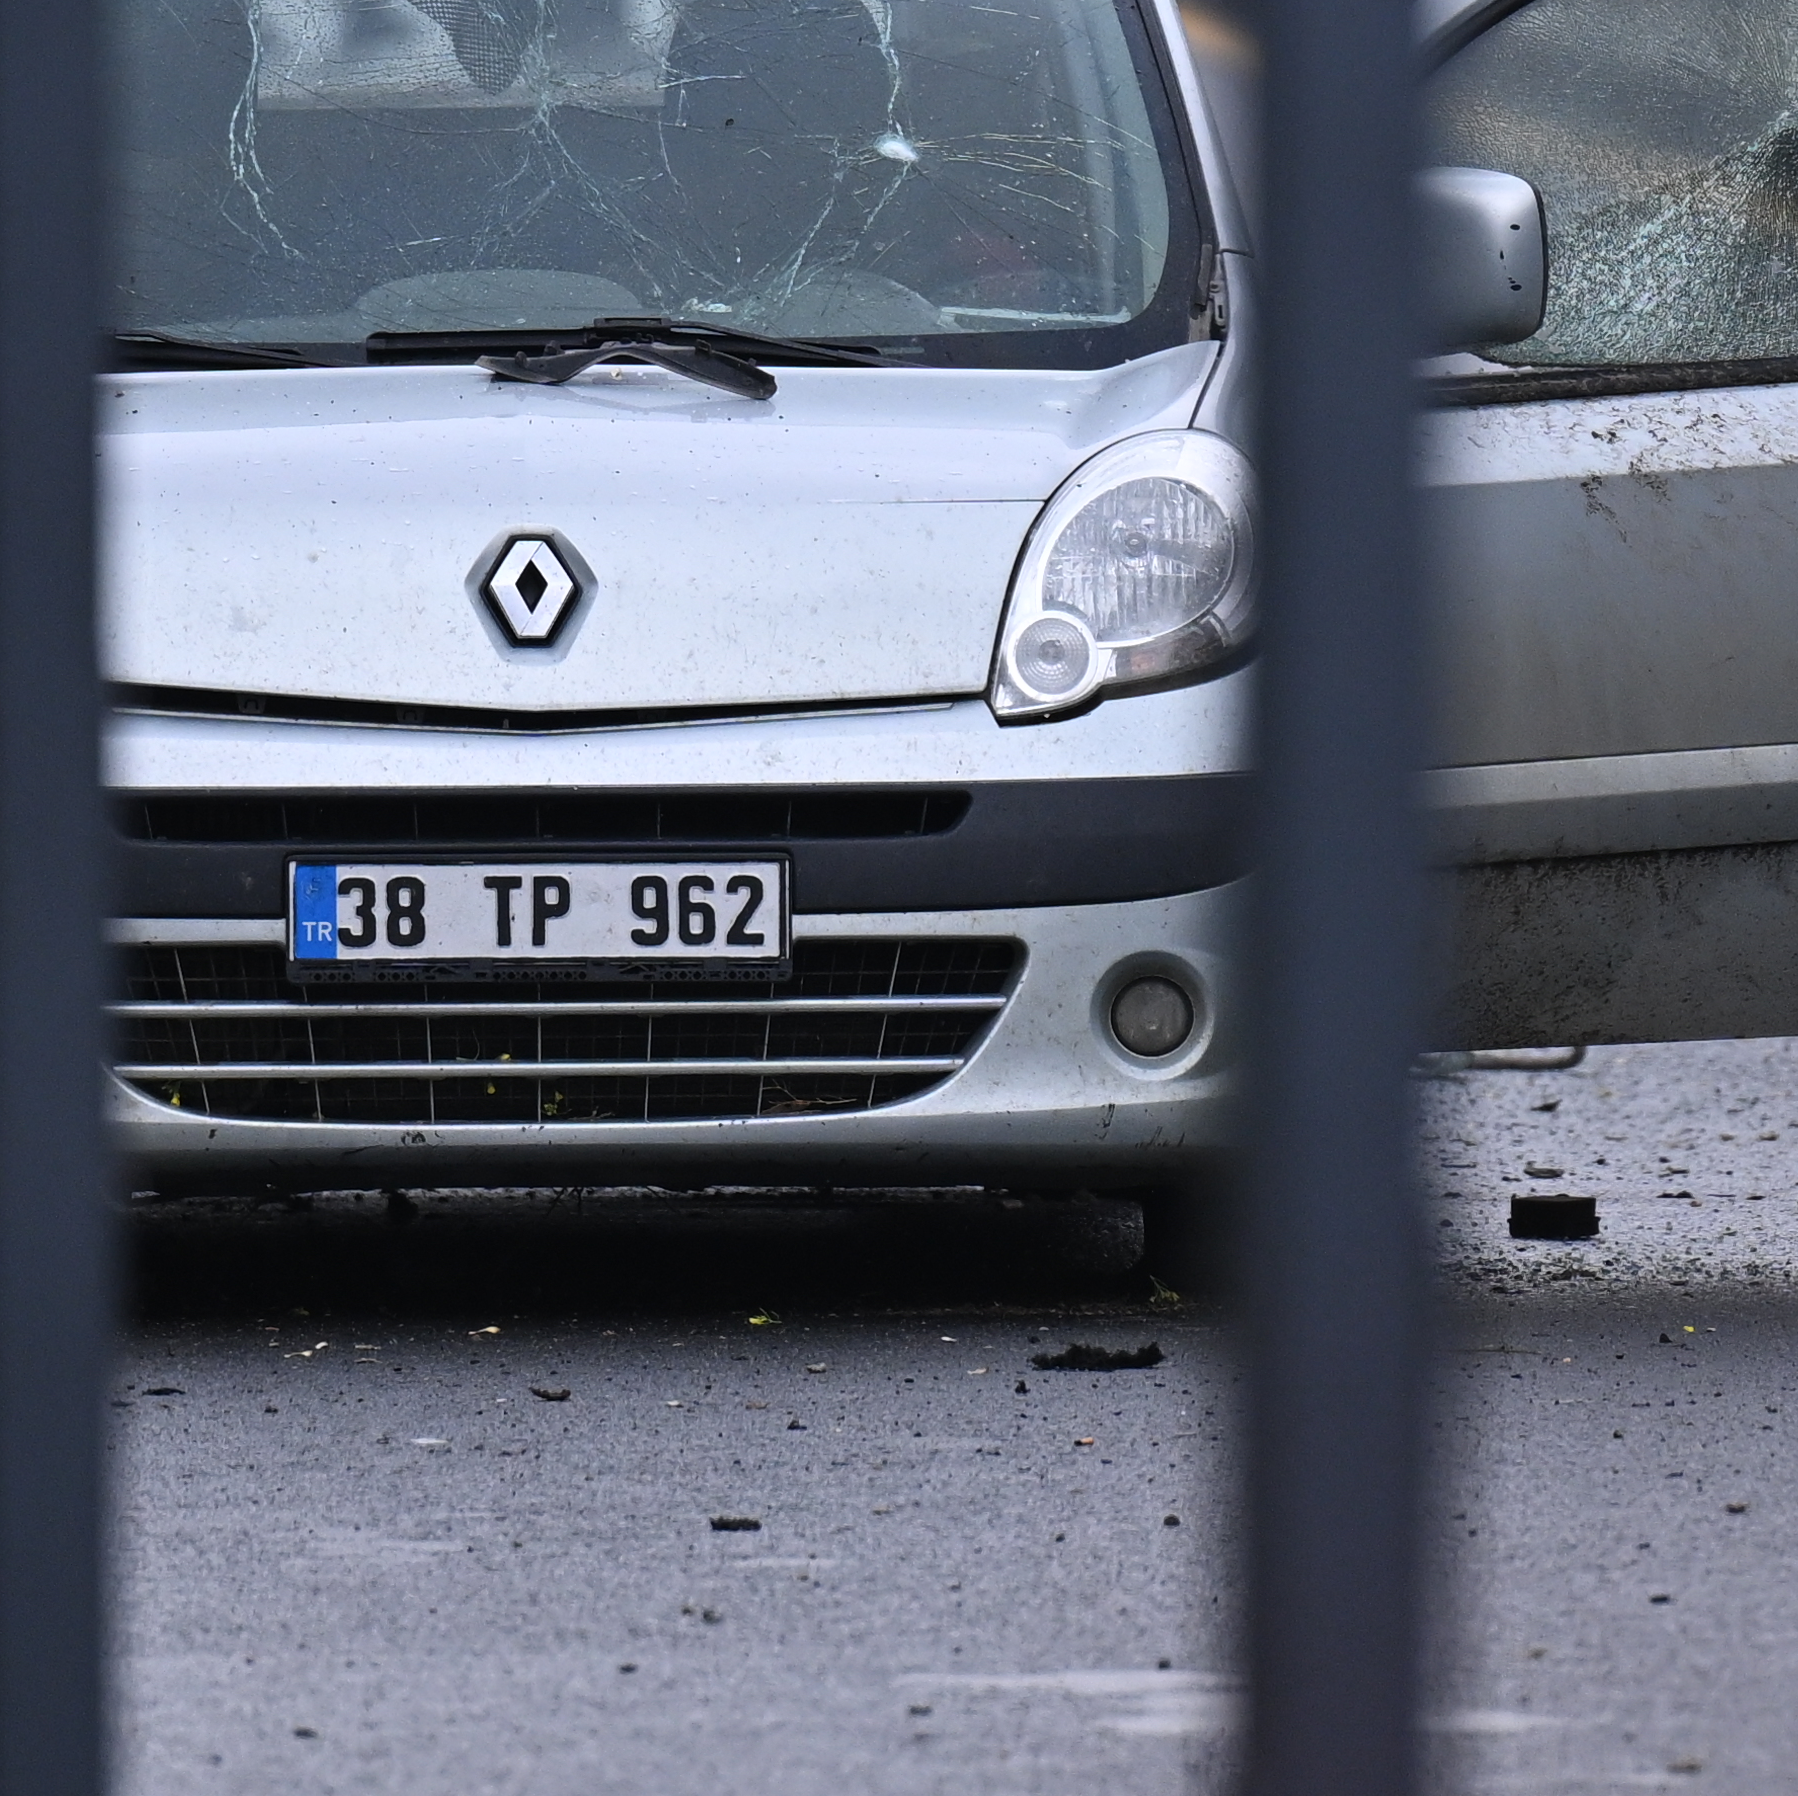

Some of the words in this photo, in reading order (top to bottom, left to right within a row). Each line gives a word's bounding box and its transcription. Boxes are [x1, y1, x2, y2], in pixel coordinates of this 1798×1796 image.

[302, 921, 333, 942] TR
[337, 876, 427, 948] 38
[484, 875, 571, 948] TP
[630, 875, 766, 947] 962
